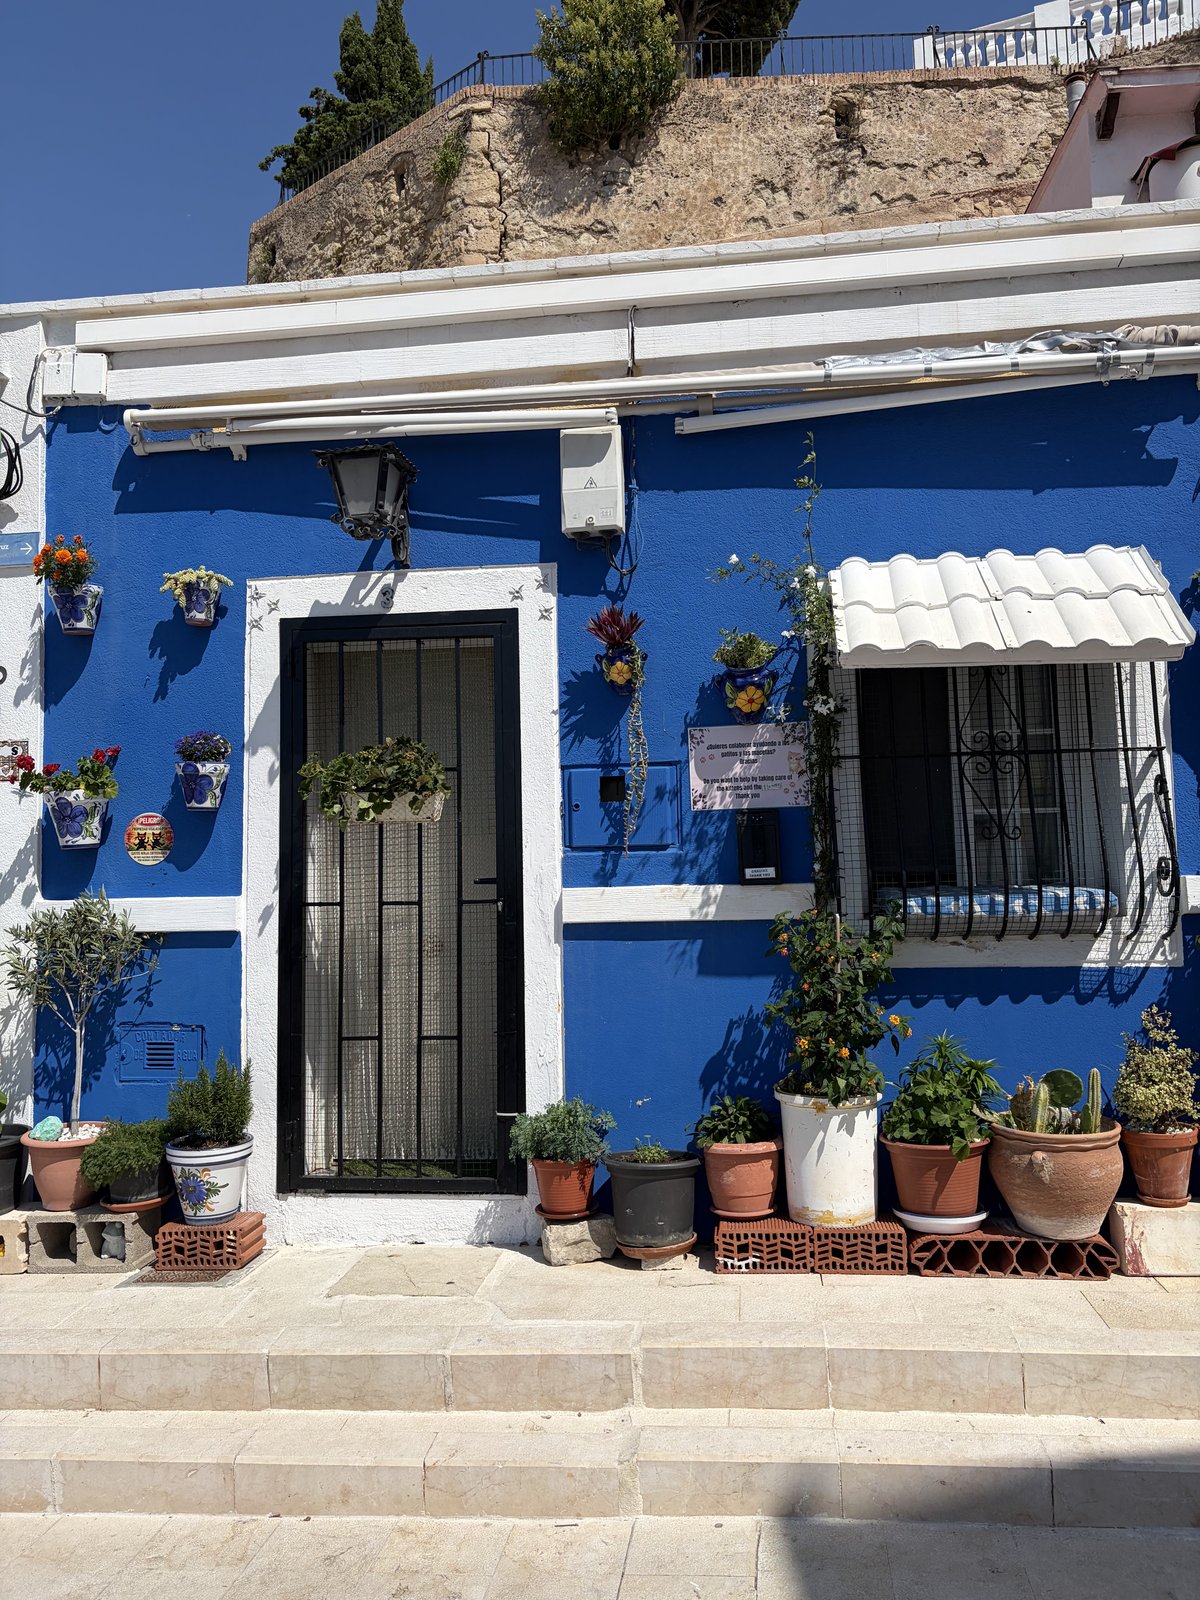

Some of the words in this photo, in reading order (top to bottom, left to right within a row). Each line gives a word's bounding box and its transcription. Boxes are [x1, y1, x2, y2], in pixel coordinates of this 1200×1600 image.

[380, 586, 394, 609] 3
[740, 776, 751, 784] help
[758, 775, 775, 783] taking
